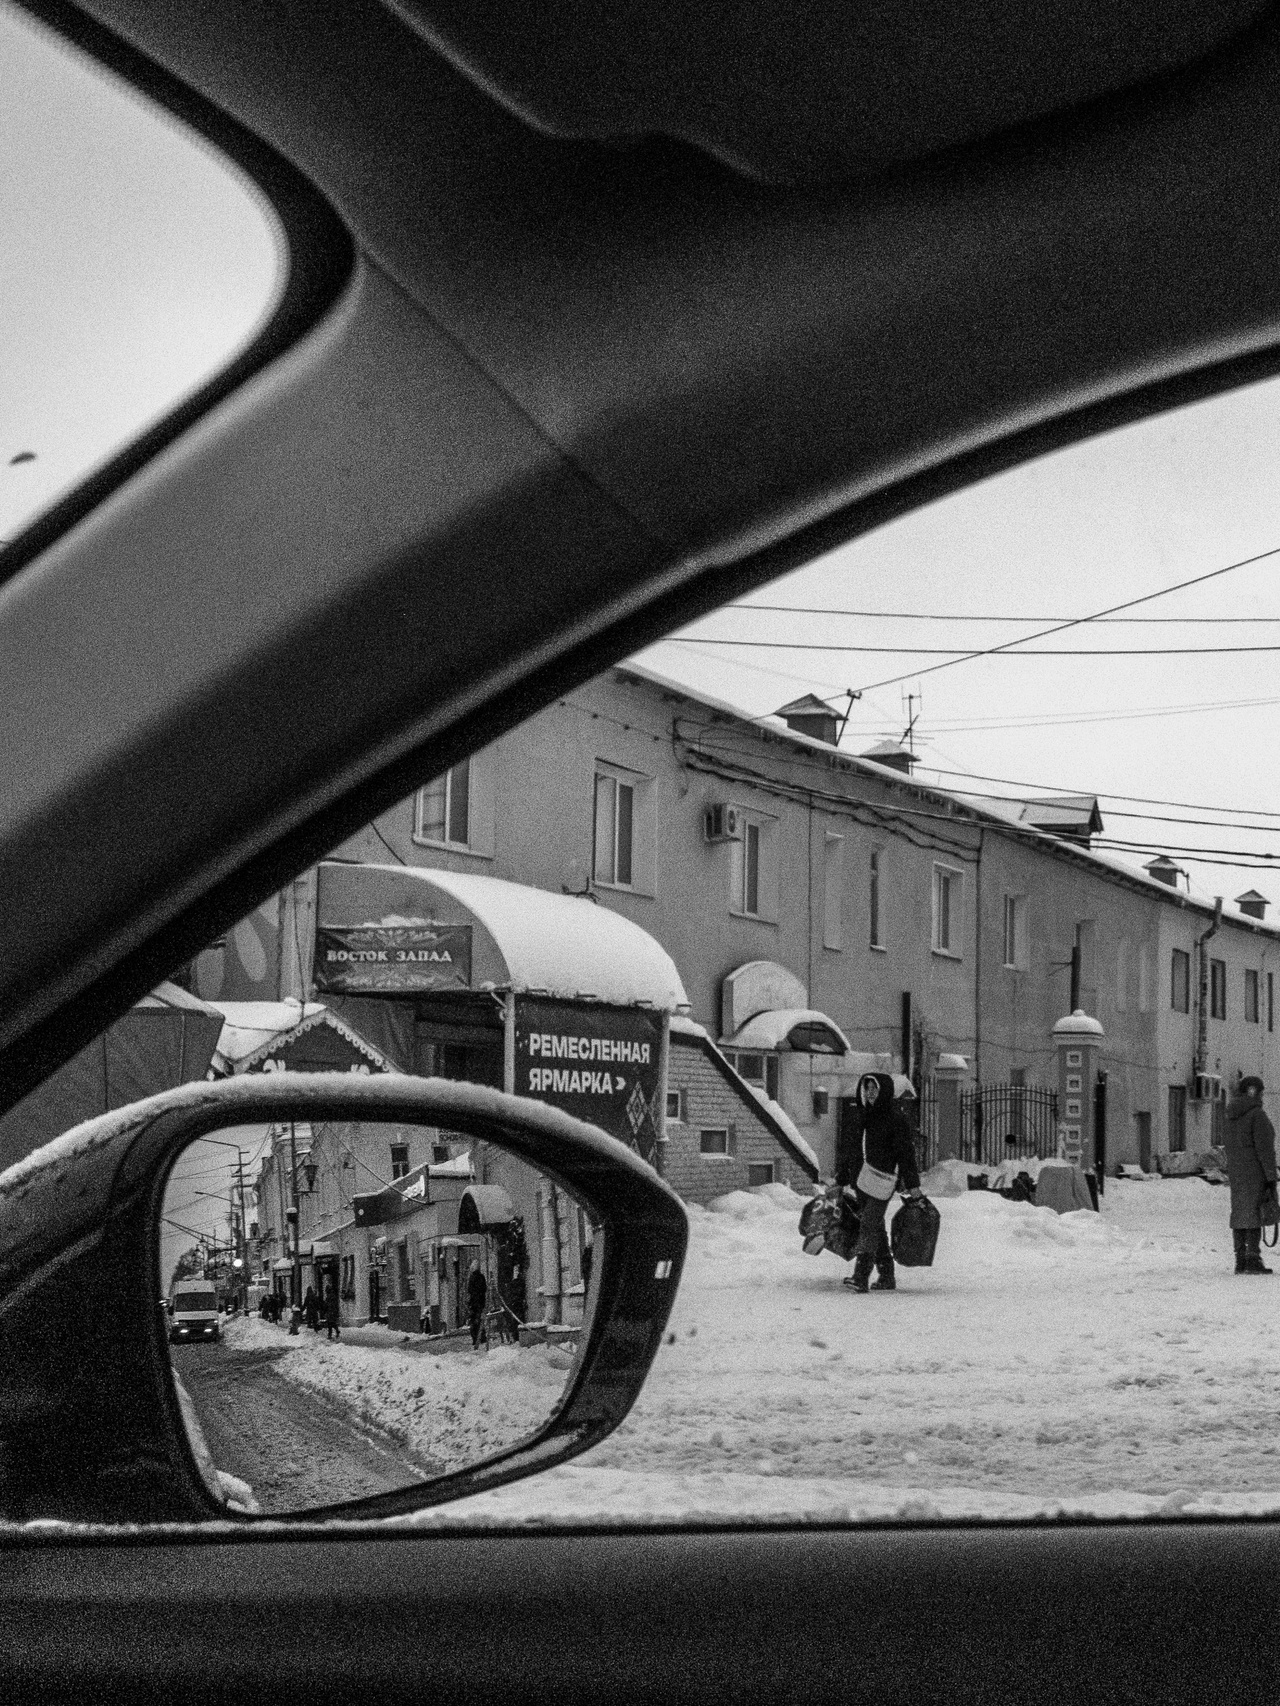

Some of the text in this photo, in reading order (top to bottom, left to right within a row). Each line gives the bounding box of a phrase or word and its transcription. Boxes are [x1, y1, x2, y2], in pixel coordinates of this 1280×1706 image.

[326, 949, 452, 962] ВОСТОК ЗАПАД
[529, 1032, 650, 1064] РЕМЕСЛЕННАЯ
[528, 1067, 613, 1094] ЯРМАРКА
